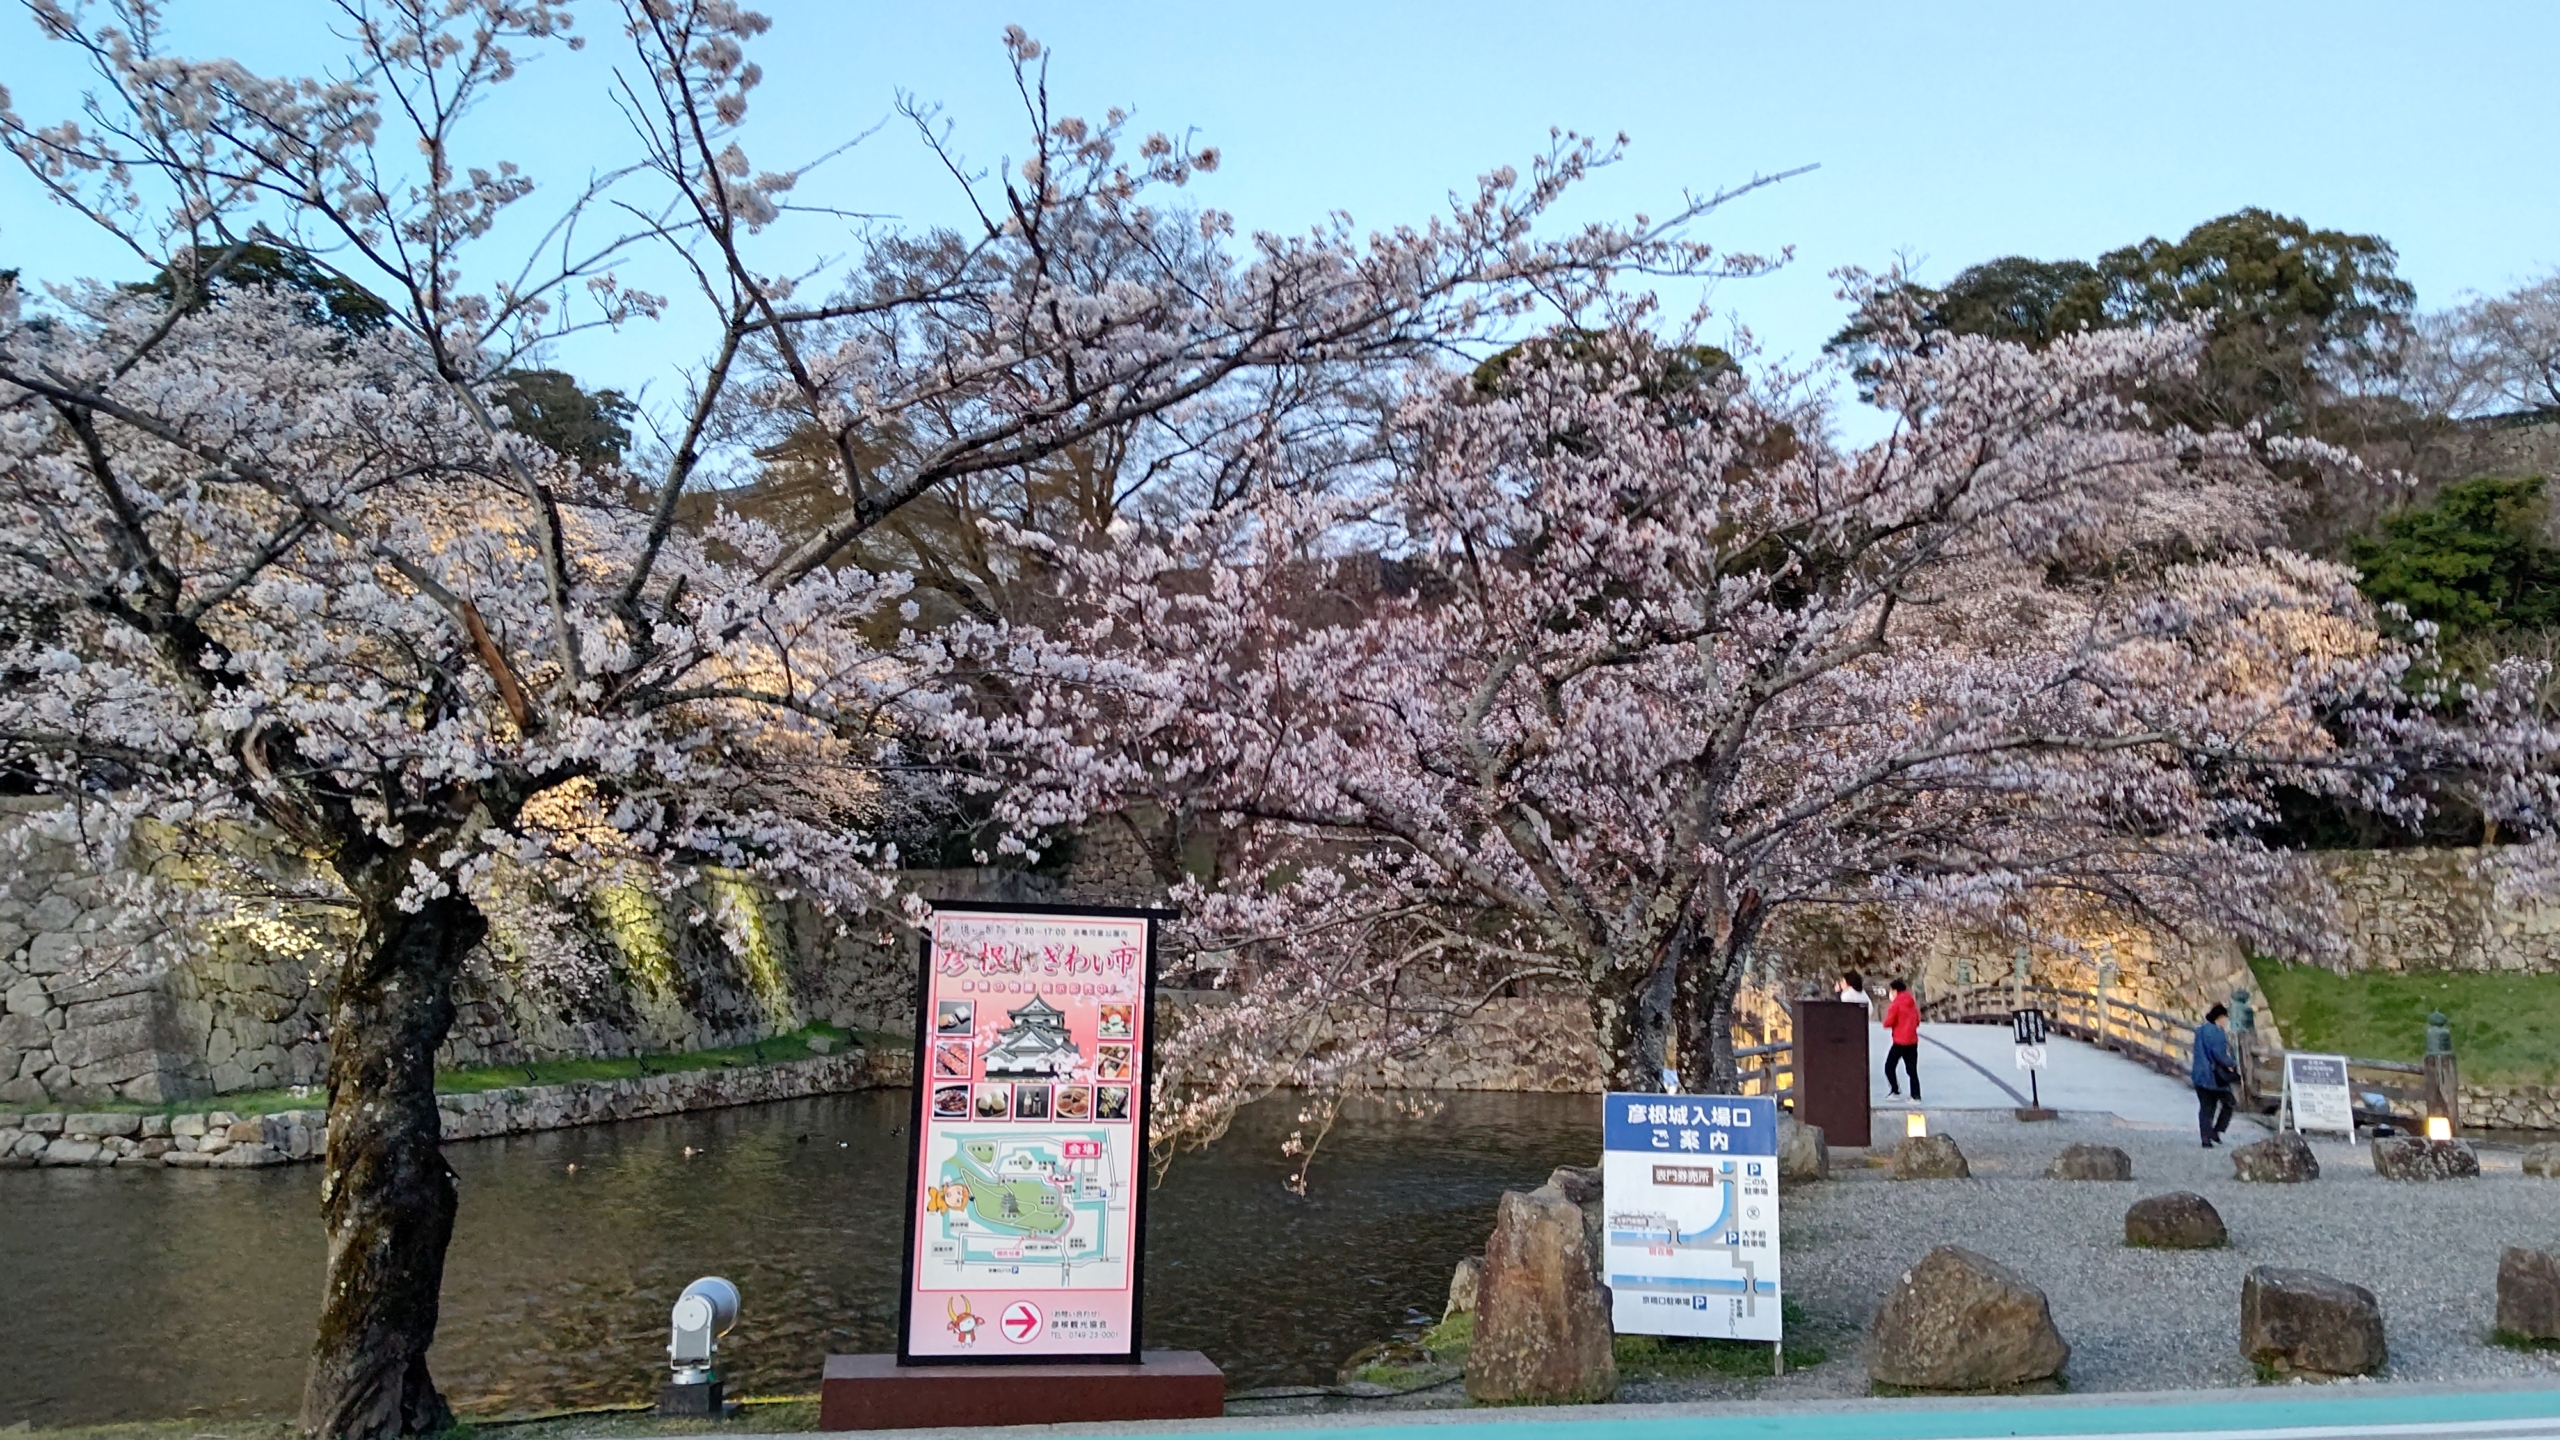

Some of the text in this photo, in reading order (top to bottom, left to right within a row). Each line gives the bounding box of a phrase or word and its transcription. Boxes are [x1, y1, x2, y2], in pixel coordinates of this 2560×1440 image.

[1627, 1103, 1752, 1128] 彦根城入場口
[1651, 1129, 1730, 1151] ご案内
[1655, 1168, 1710, 1184] 表門券売所
[1744, 1178, 1768, 1187] 二の丸
[1744, 1187, 1769, 1196] 駐車場
[1742, 1229, 1767, 1239] 大手前
[1742, 1239, 1767, 1248] 駐車場
